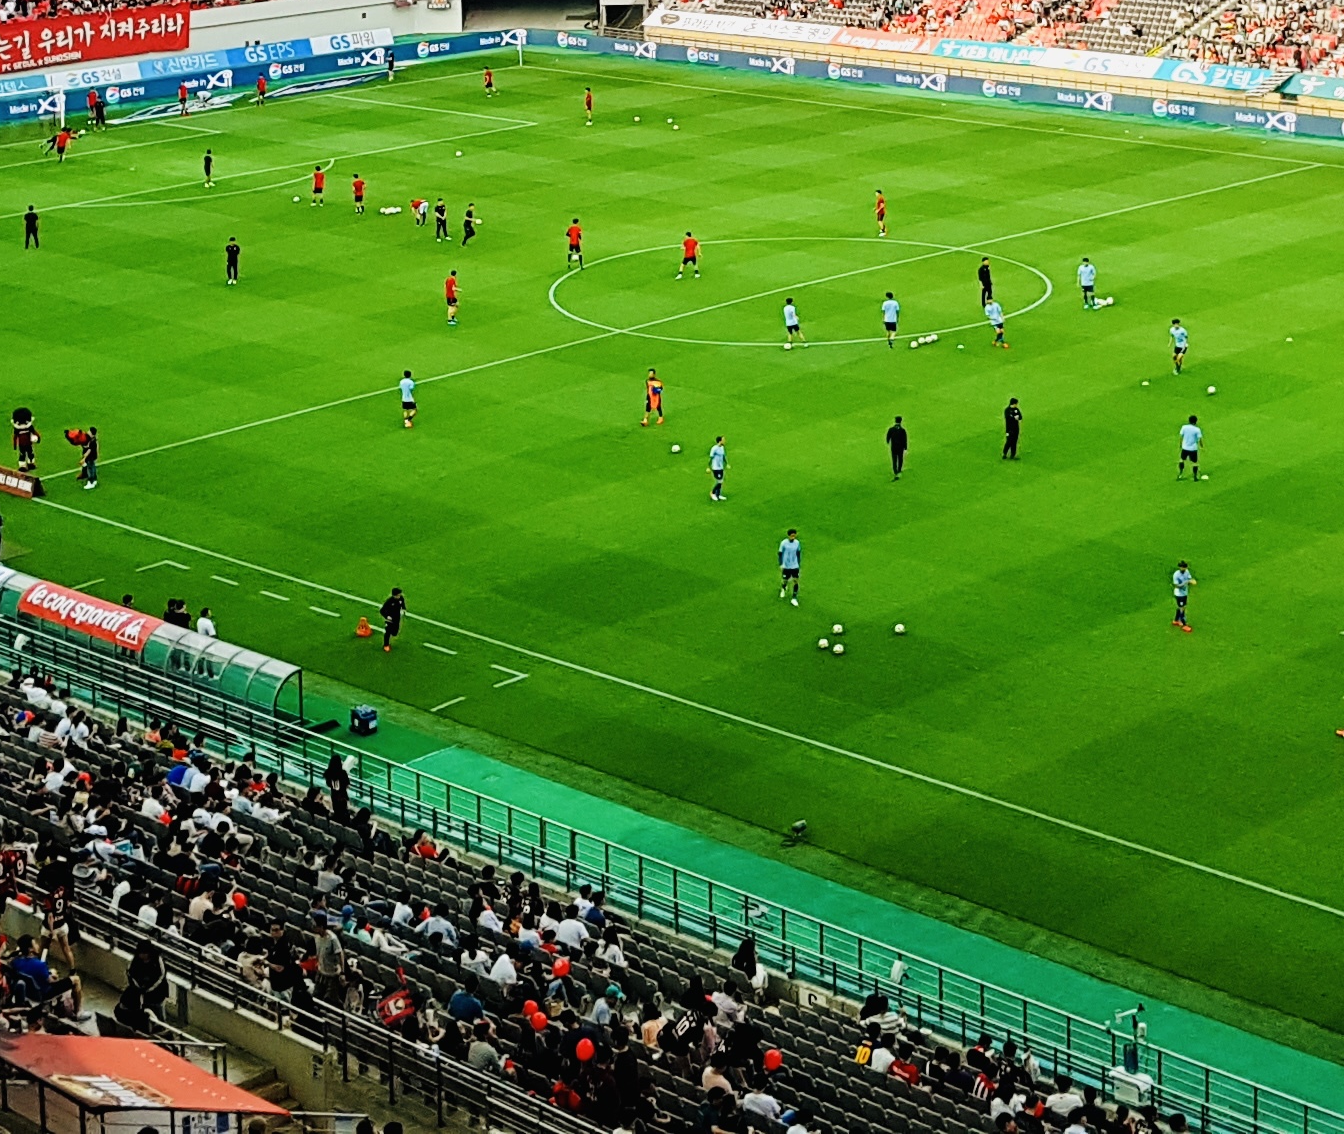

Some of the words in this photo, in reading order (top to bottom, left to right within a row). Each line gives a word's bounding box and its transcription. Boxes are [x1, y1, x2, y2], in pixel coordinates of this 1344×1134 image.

[38, 21, 95, 54] 우리가
[100, 13, 185, 42] 지켜주리라
[330, 35, 351, 50] GS
[244, 45, 267, 62] GS
[270, 42, 296, 60] EPS
[168, 53, 219, 73] 신한카드
[1084, 56, 1109, 73] GS
[81, 71, 99, 84] GS
[1171, 63, 1207, 84] GS
[1057, 92, 1074, 103] Made
[1076, 94, 1083, 103] in
[1168, 104, 1180, 115] GS
[1235, 112, 1255, 123] Made
[1256, 114, 1265, 123] in
[26, 584, 47, 604] le
[42, 592, 76, 615] coq
[69, 602, 133, 633] sportif
[17, 859, 25, 875] 9
[56, 899, 64, 913] 9
